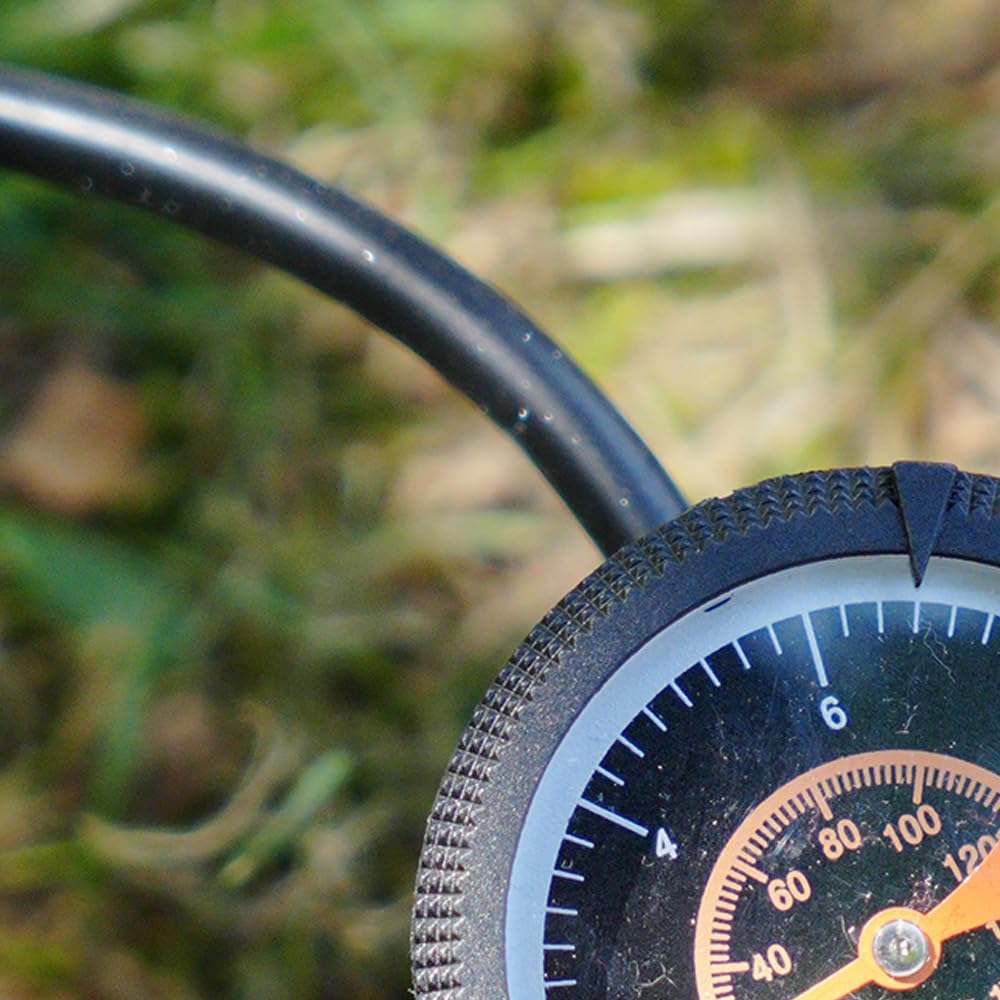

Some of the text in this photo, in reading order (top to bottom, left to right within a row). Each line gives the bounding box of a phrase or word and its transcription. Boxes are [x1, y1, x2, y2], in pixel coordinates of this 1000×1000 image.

[819, 696, 848, 730] 6
[655, 829, 678, 860] 4
[818, 819, 861, 860] 80
[883, 804, 942, 852] 100
[767, 870, 811, 911] 60
[751, 944, 792, 981] 40
